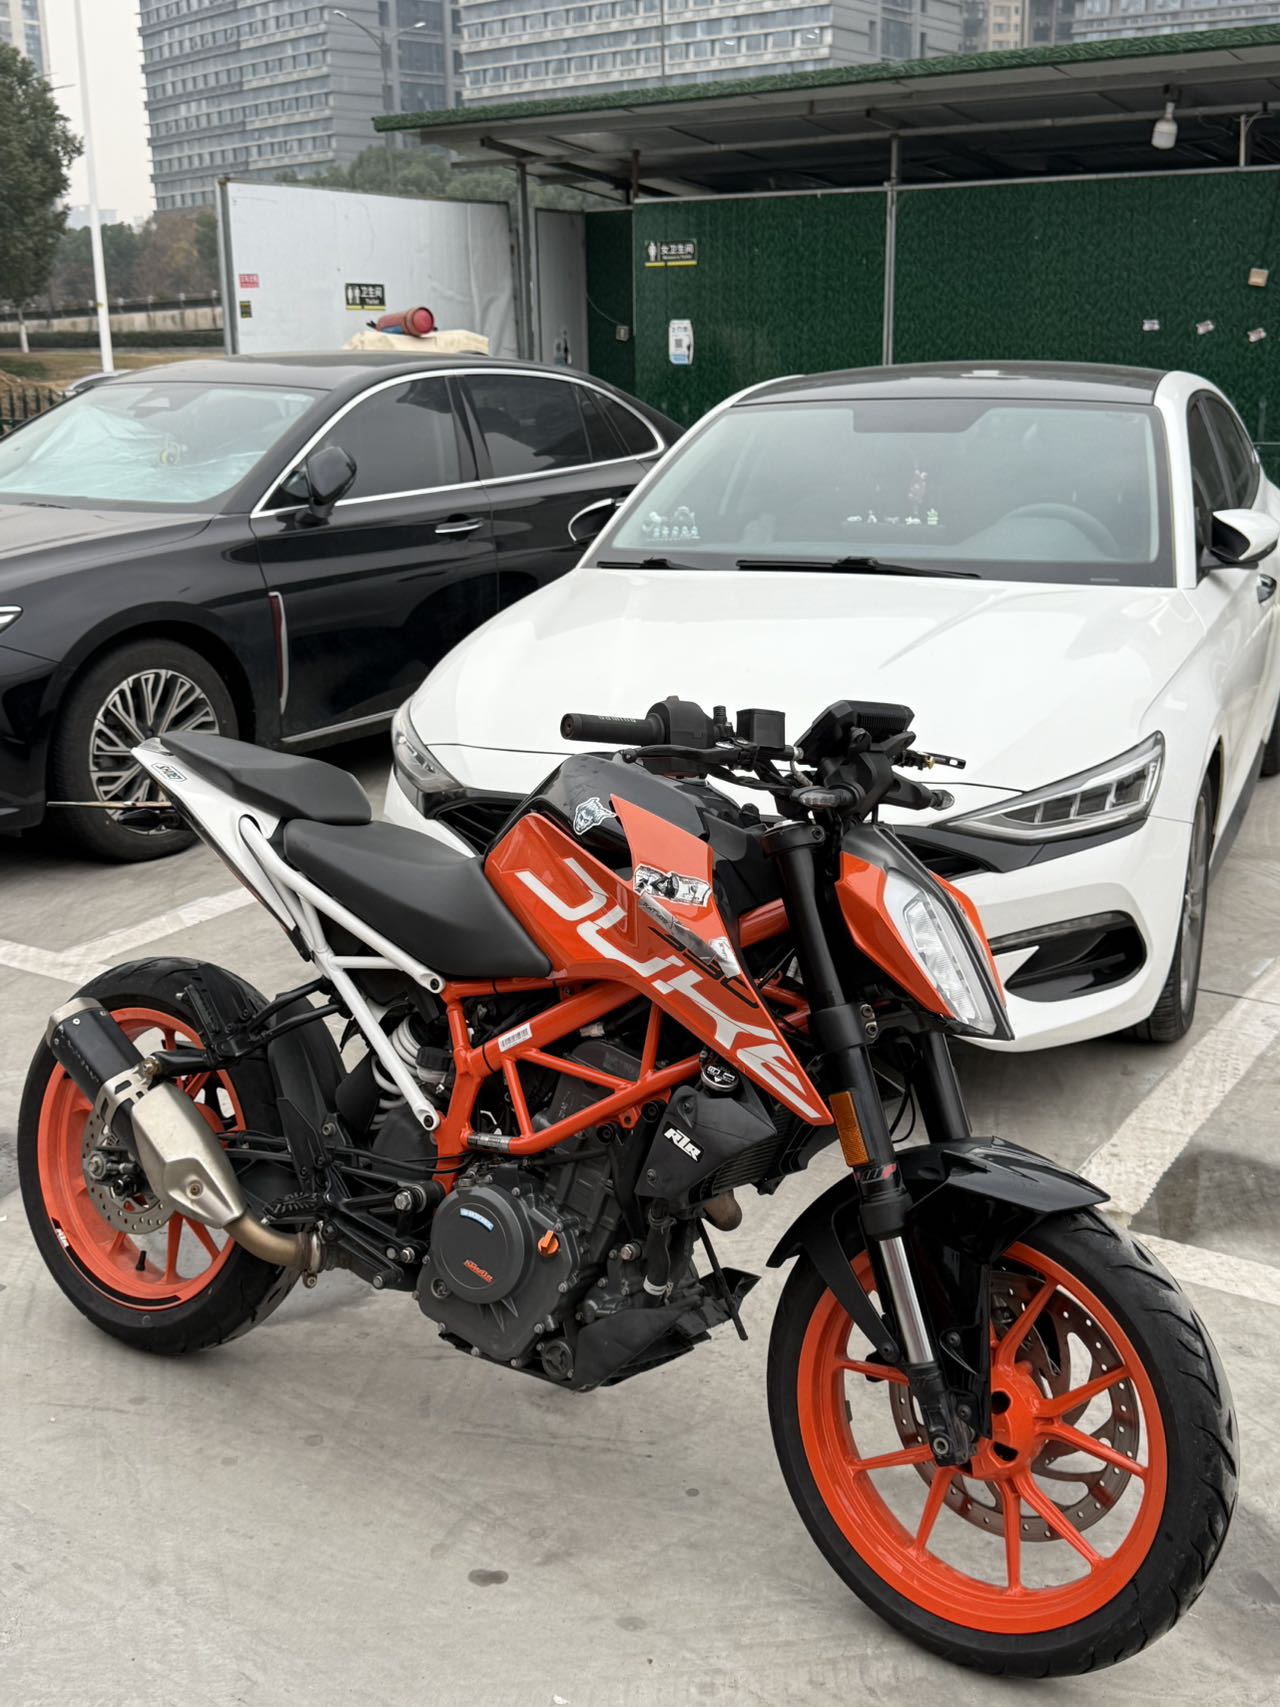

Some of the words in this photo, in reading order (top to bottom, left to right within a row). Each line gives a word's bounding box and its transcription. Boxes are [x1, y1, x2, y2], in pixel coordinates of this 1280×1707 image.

[661, 243, 695, 255] 女卫生间
[360, 286, 383, 298] 卫生间
